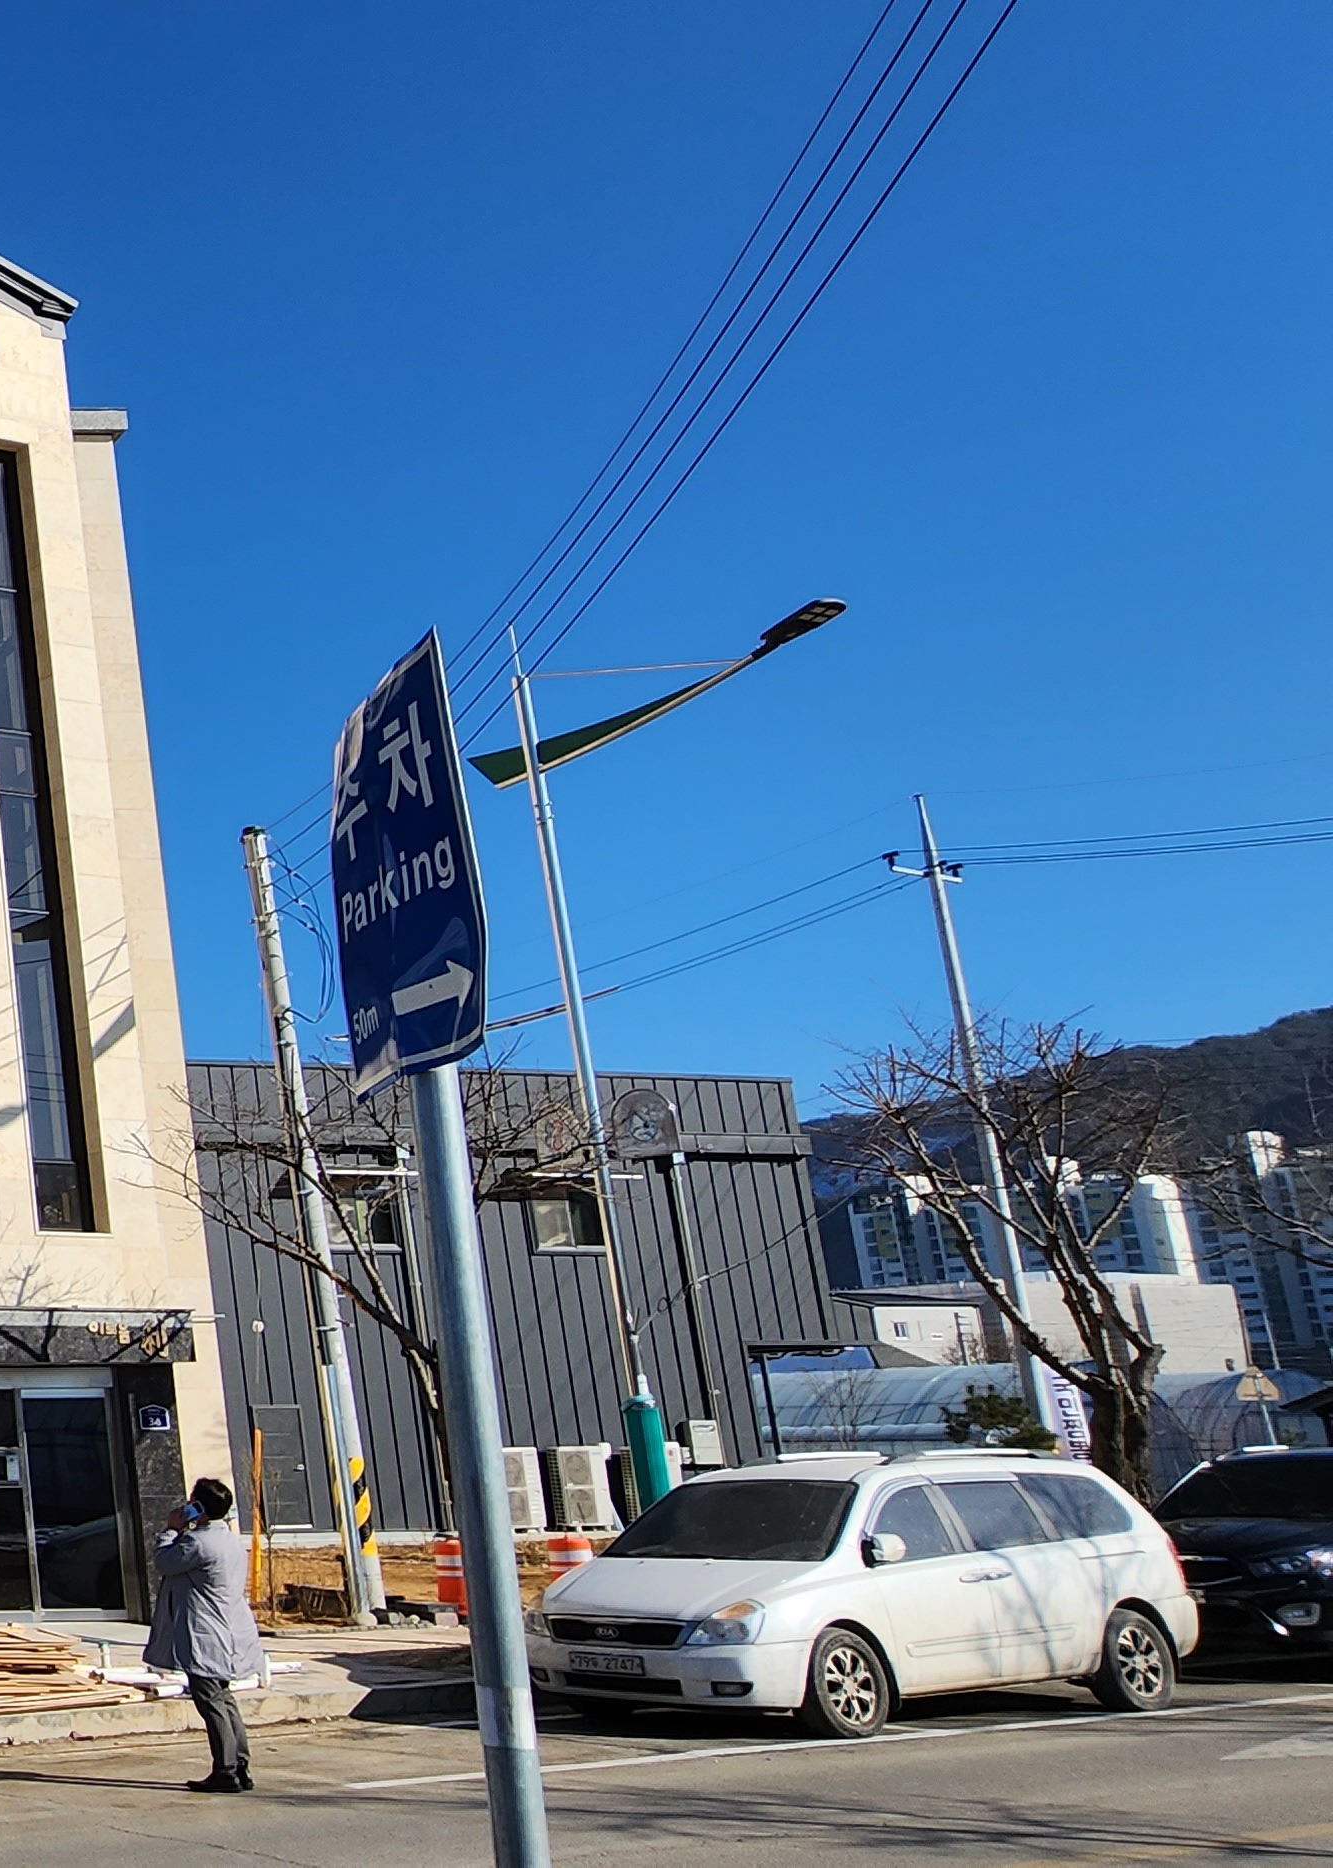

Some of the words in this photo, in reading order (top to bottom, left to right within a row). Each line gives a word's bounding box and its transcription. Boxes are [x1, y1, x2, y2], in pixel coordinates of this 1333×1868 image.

[336, 701, 434, 862] 주차
[342, 836, 455, 944] Parking
[353, 1005, 380, 1046] 50m
[597, 1627, 615, 1638] KIA
